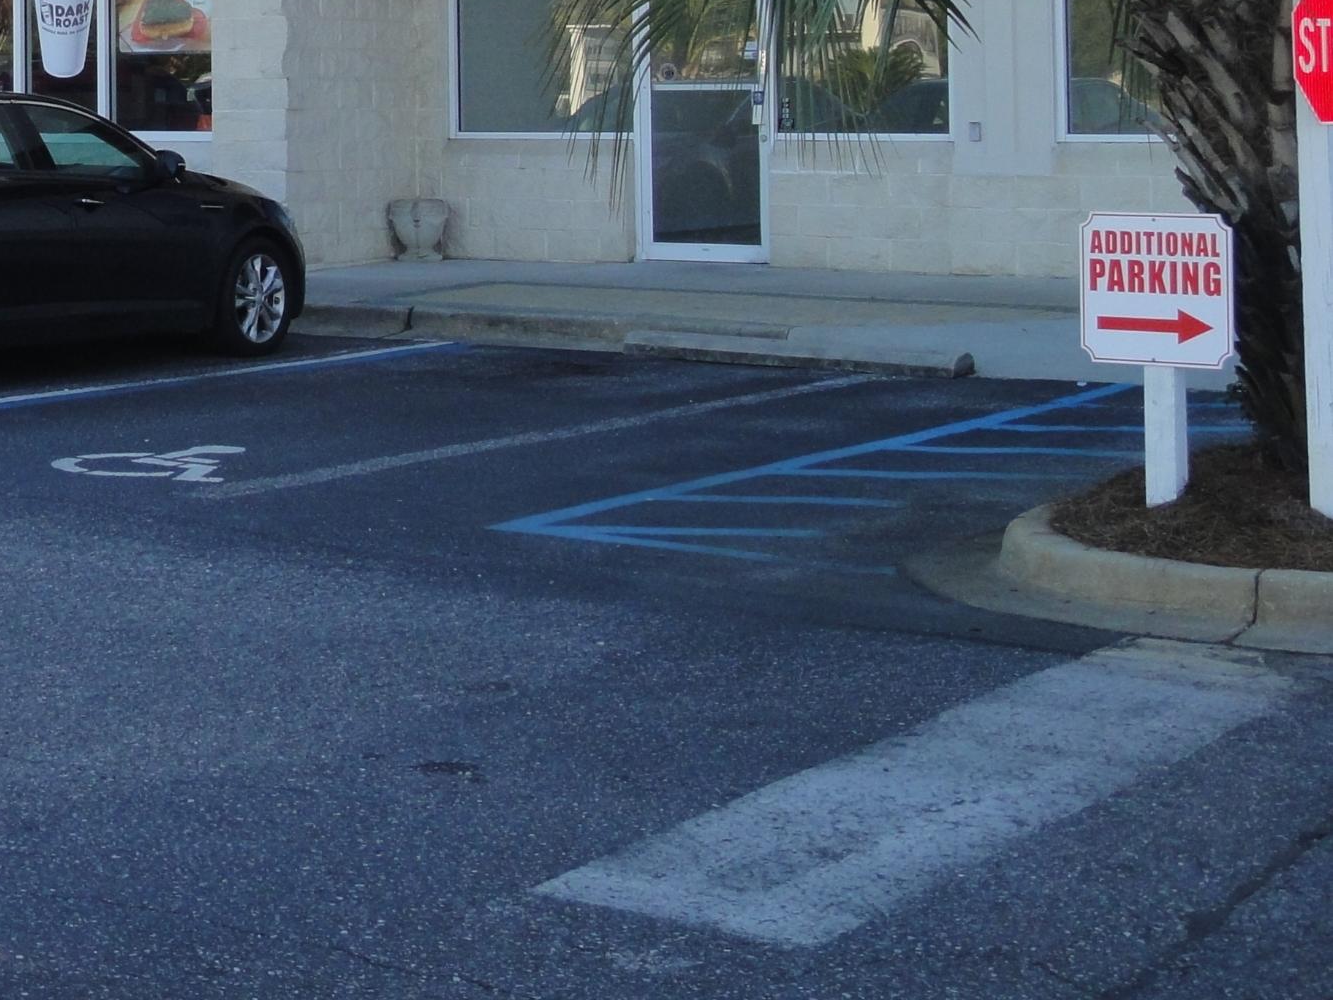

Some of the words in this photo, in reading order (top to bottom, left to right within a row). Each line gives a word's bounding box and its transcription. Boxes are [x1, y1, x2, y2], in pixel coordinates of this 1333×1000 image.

[55, 0, 91, 18] DARK
[55, 12, 89, 28] ROAST
[1298, 16, 1333, 74] ST
[1090, 229, 1221, 258] ADDITIONAL
[1089, 258, 1222, 297] PARKING
